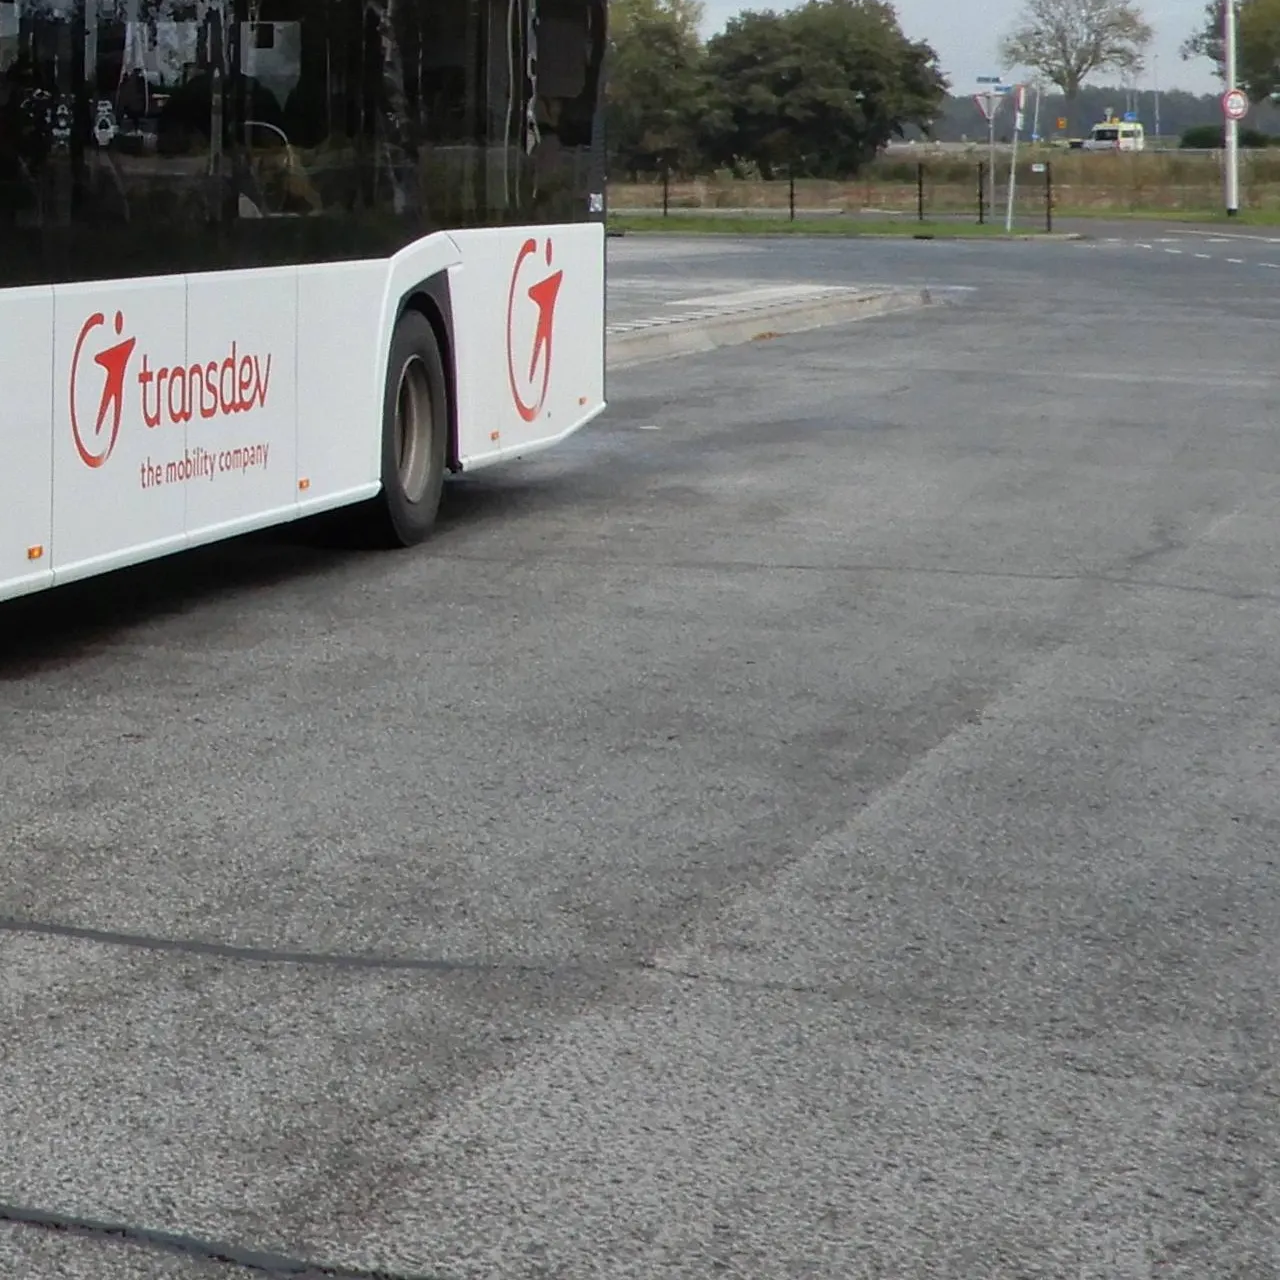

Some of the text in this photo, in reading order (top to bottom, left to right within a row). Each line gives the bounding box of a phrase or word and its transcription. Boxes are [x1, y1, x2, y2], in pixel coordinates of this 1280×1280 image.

[138, 340, 271, 428] transdev
[140, 442, 269, 489] the mobility company
